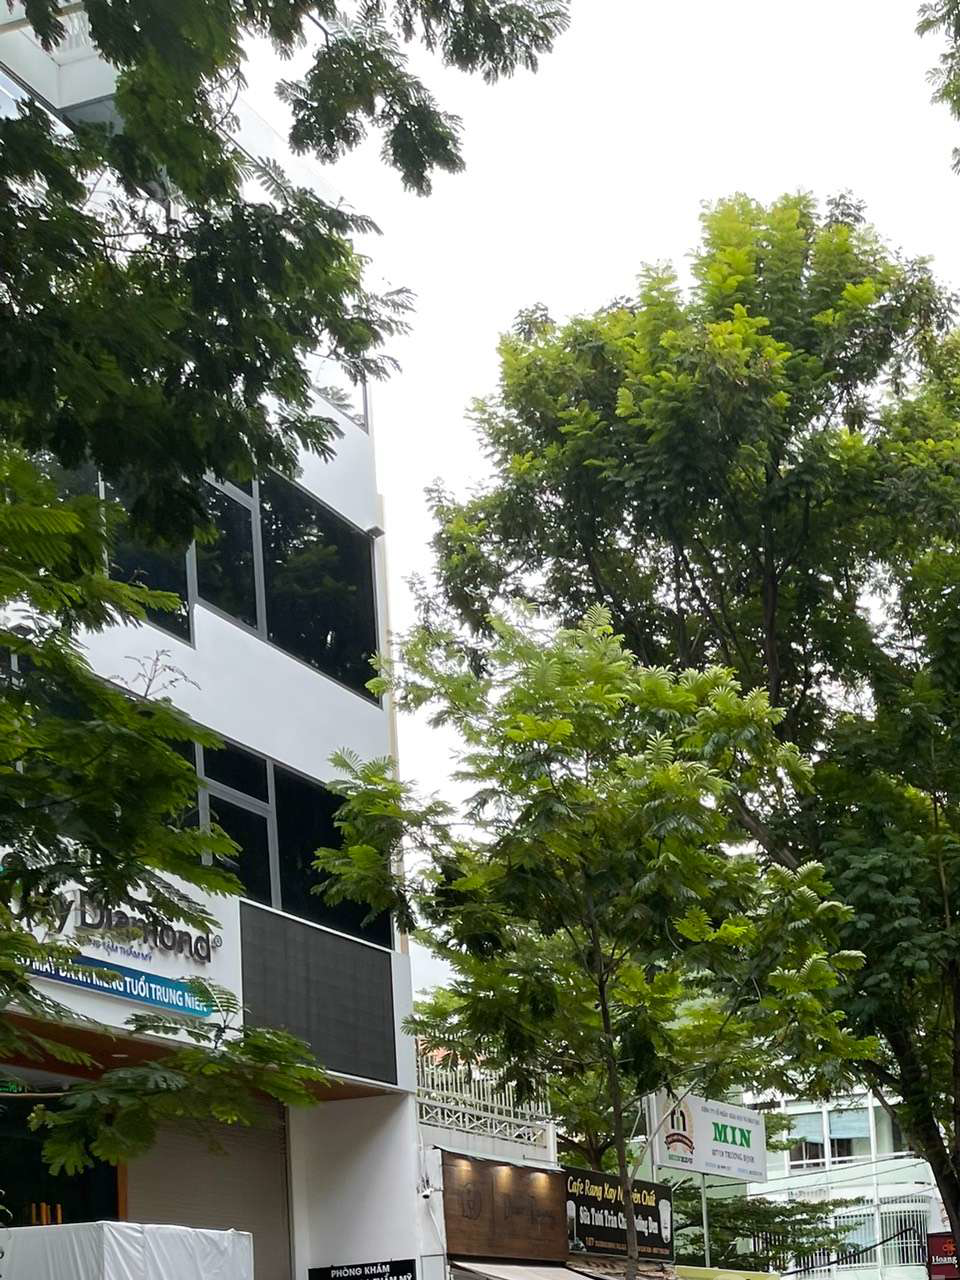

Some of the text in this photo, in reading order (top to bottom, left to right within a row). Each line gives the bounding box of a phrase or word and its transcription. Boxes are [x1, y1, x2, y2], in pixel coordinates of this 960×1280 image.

[124, 975, 149, 998] TUỔI
[150, 984, 182, 1006] TRUNG
[712, 1122, 752, 1148] MIN
[585, 1179, 602, 1201] Rang
[604, 1183, 617, 1203] Xay
[331, 1264, 390, 1278] PHÒNG KHÁM
